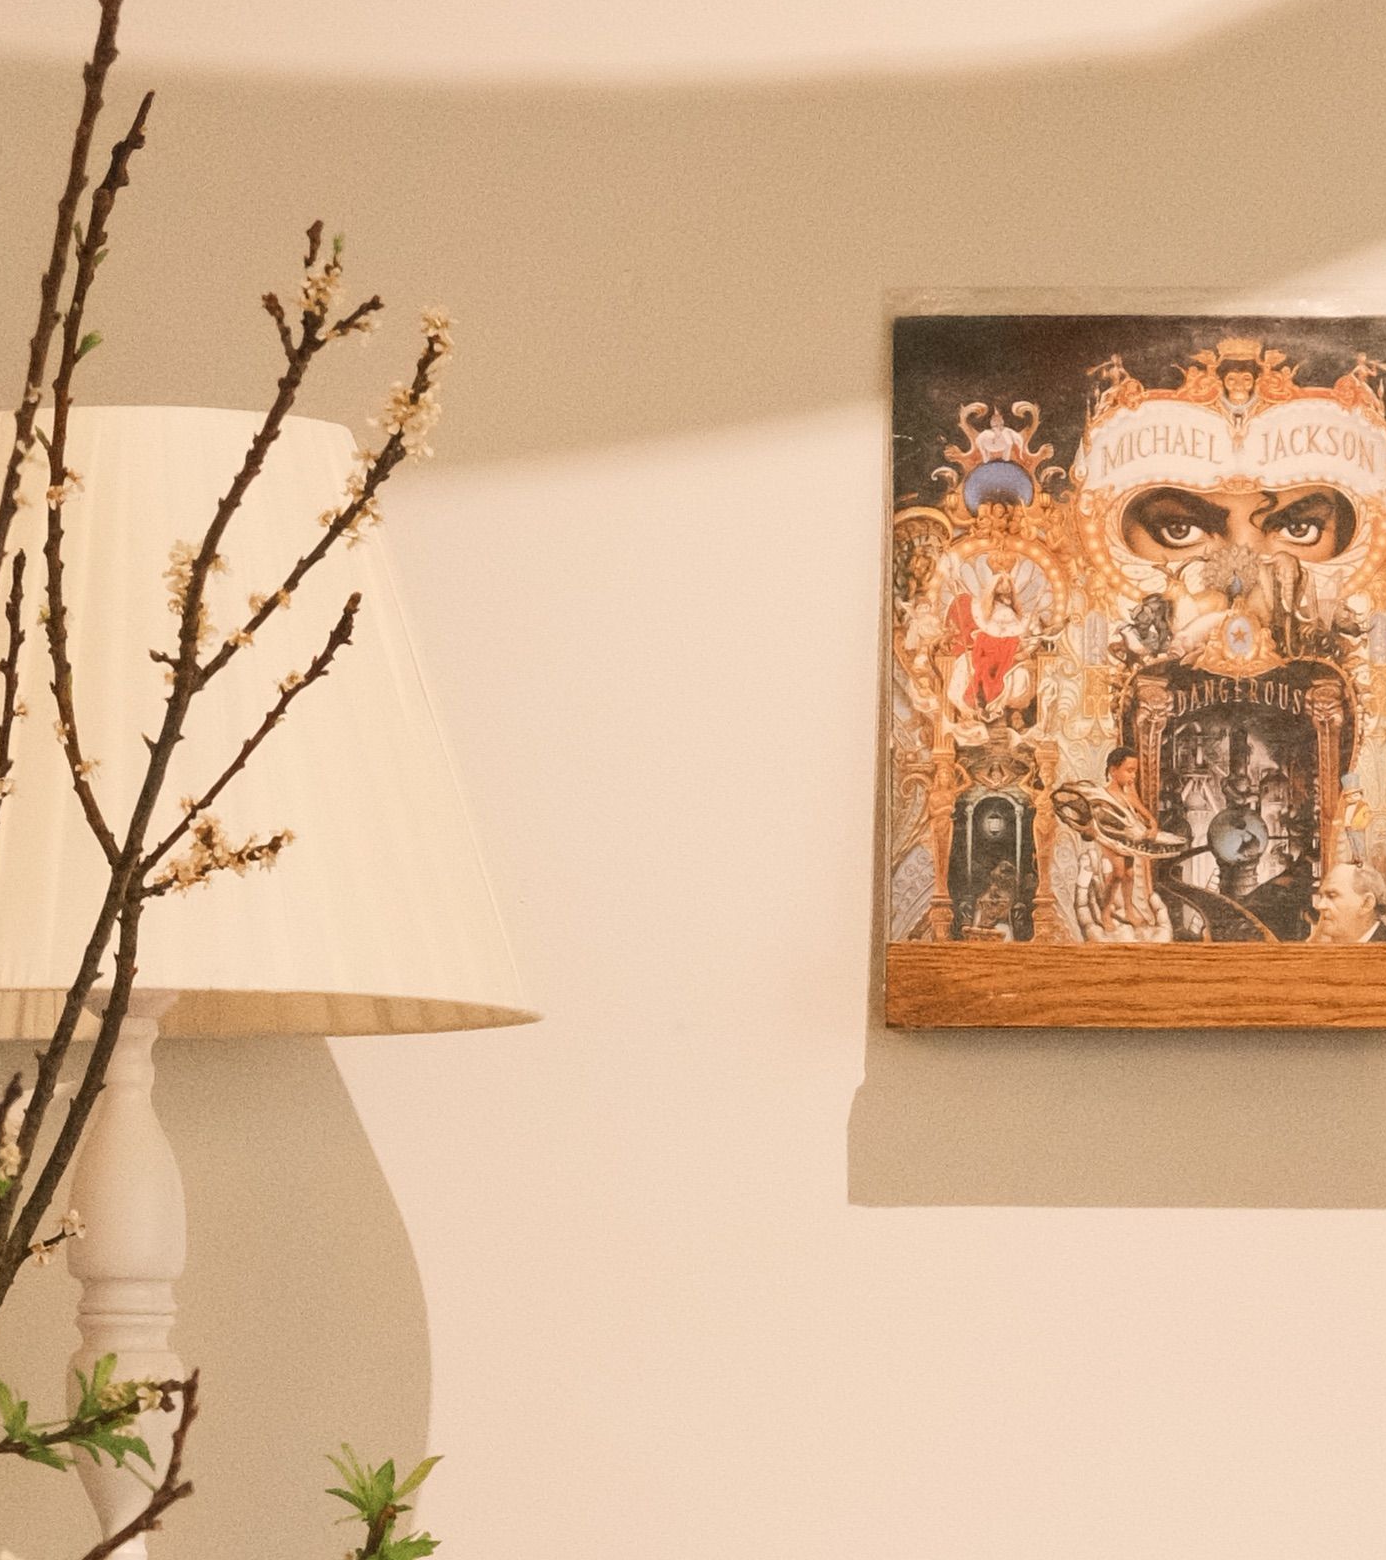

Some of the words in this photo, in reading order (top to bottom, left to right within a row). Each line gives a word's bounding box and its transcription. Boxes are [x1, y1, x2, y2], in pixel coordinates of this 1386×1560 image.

[1101, 423, 1222, 477] MICHAEL
[1259, 423, 1376, 473] JACKSON
[1177, 677, 1303, 717] DANGEROUS
